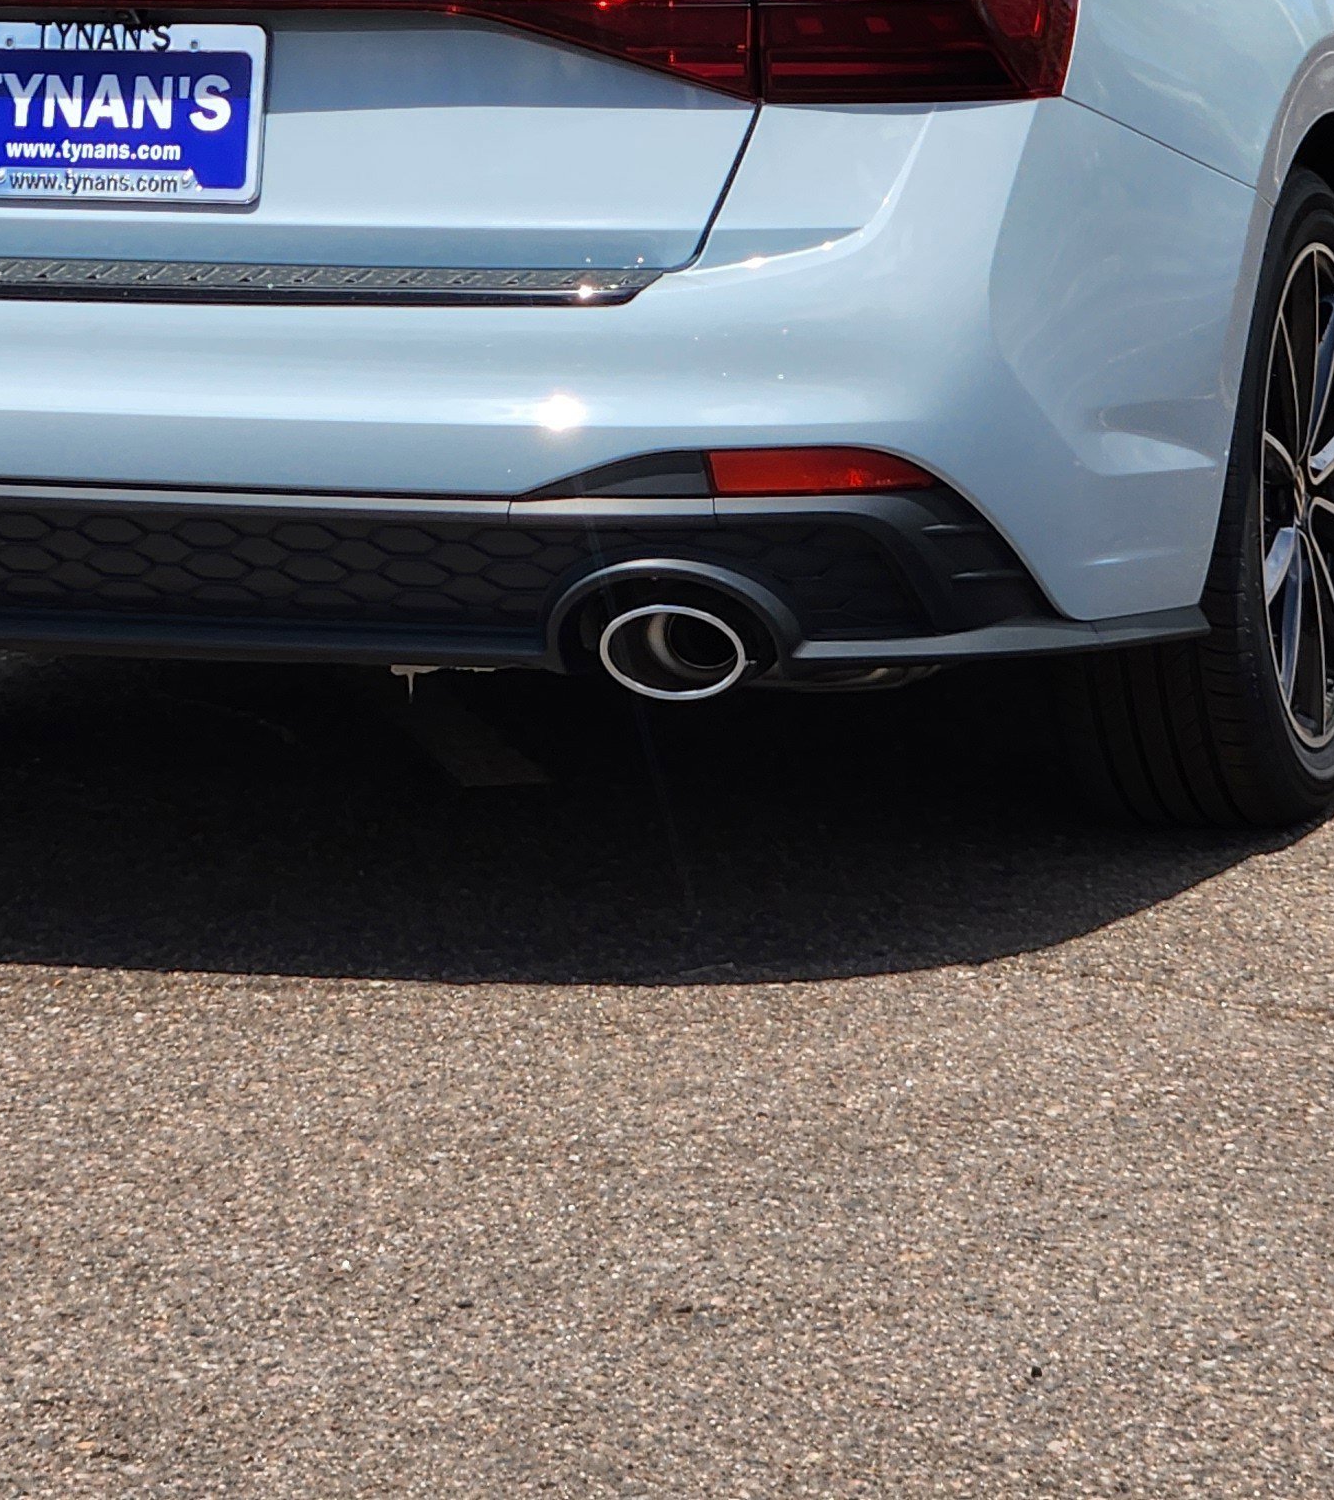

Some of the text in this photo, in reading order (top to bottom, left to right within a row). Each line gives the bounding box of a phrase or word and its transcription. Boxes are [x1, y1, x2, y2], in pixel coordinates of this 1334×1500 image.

[35, 21, 172, 52] TYNAN'S
[5, 140, 182, 163] www.tynans.com
[9, 171, 179, 195] www.tynans.com
